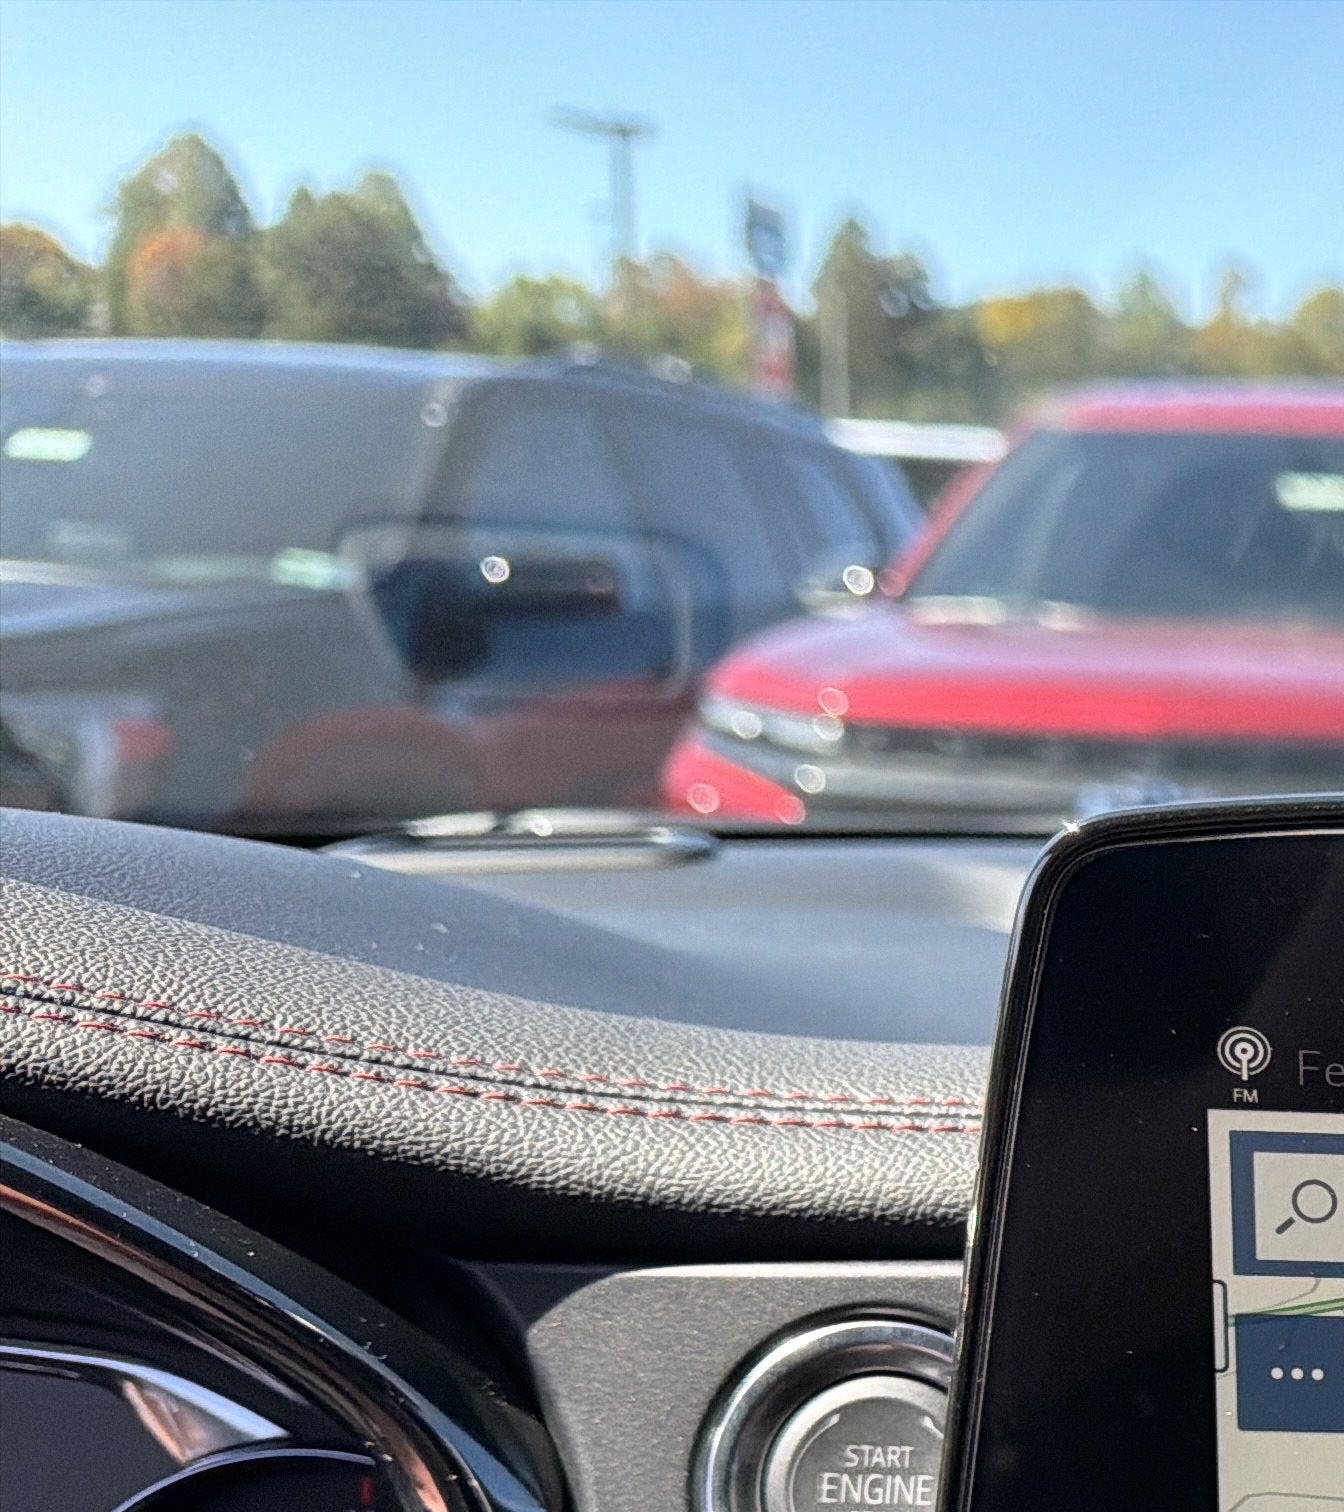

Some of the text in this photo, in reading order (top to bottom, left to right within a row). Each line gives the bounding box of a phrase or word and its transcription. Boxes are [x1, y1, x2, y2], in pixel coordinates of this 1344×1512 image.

[1232, 1088, 1259, 1104] FM
[844, 1444, 915, 1468] START
[819, 1472, 935, 1506] ENGINE
